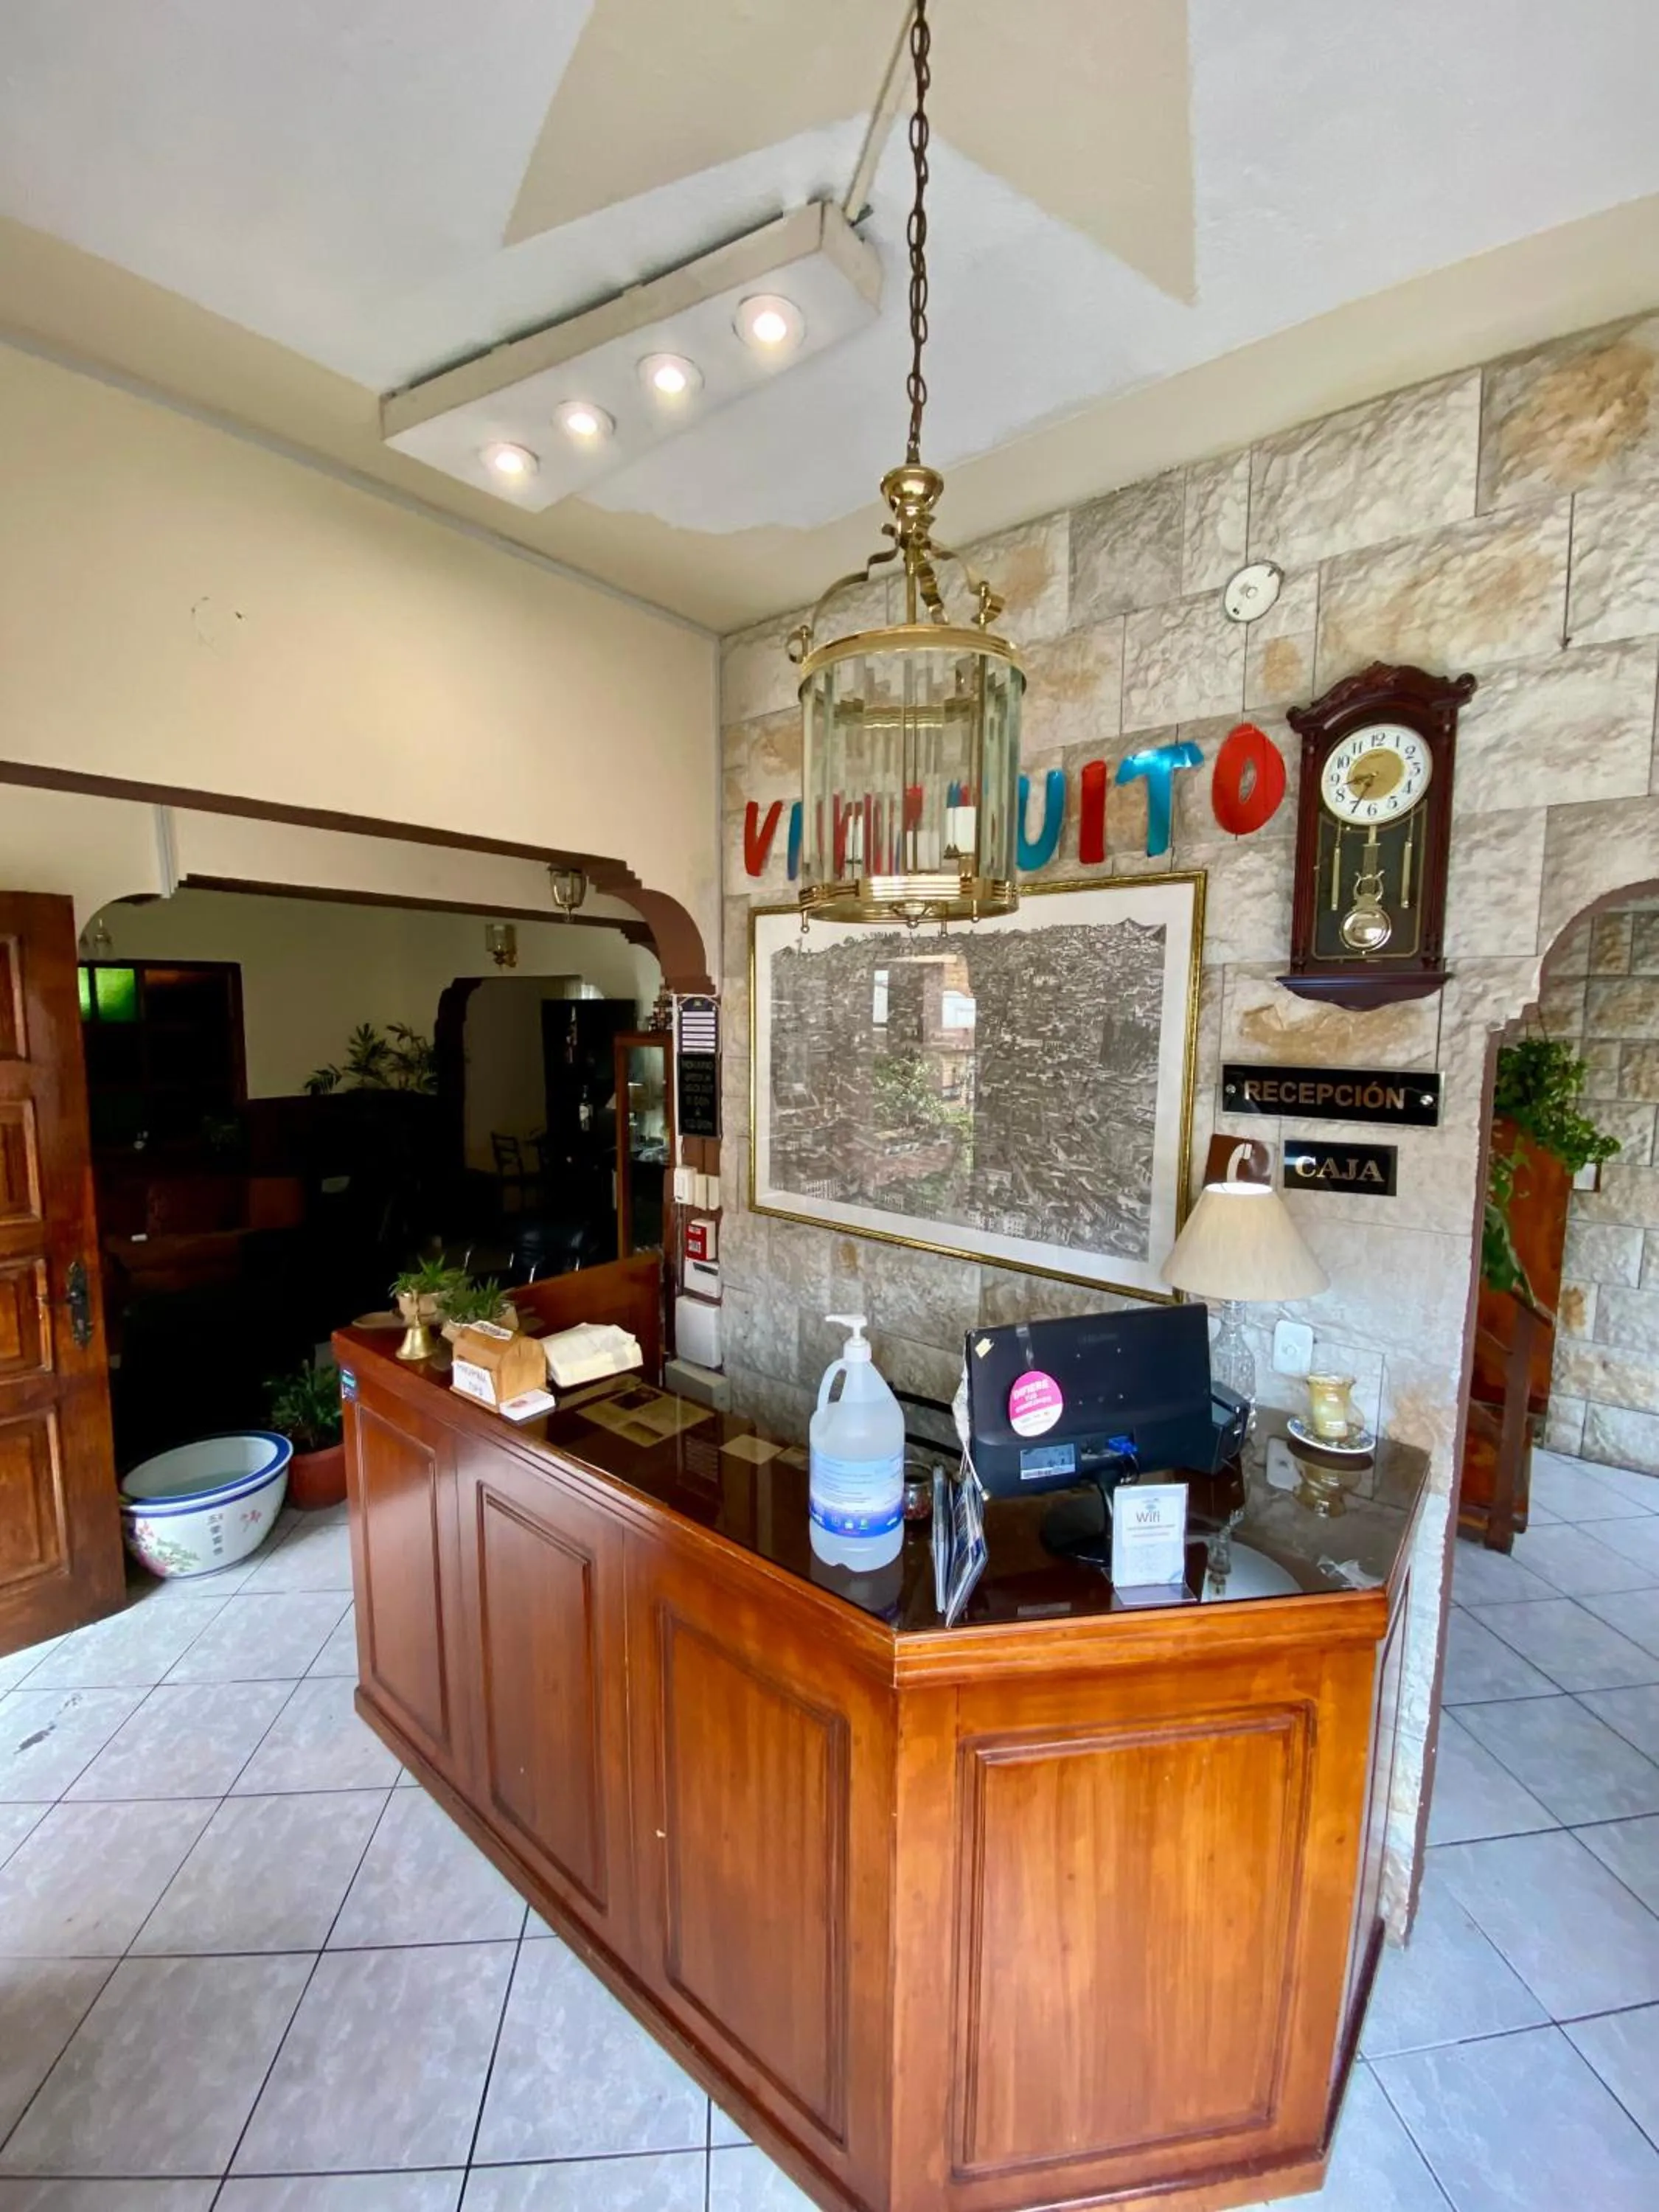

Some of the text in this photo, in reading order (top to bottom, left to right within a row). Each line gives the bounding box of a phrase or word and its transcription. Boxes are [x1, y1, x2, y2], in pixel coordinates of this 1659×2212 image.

[1371, 732, 1385, 747] 12
[1395, 734, 1400, 748] 1
[1352, 741, 1363, 754] 11
[1405, 745, 1416, 759] 2
[1337, 755, 1350, 768] 10
[1409, 762, 1421, 776] 3
[1331, 772, 1340, 785] 9
[1402, 779, 1412, 793] 4
[964, 723, 1287, 872] UITO
[1335, 788, 1345, 801] 8
[1349, 801, 1359, 815] 7
[1366, 803, 1377, 816] 6
[1388, 796, 1398, 809] 5
[1244, 1079, 1405, 1110] RECEPCIÓN
[1294, 1155, 1385, 1183] CAJA
